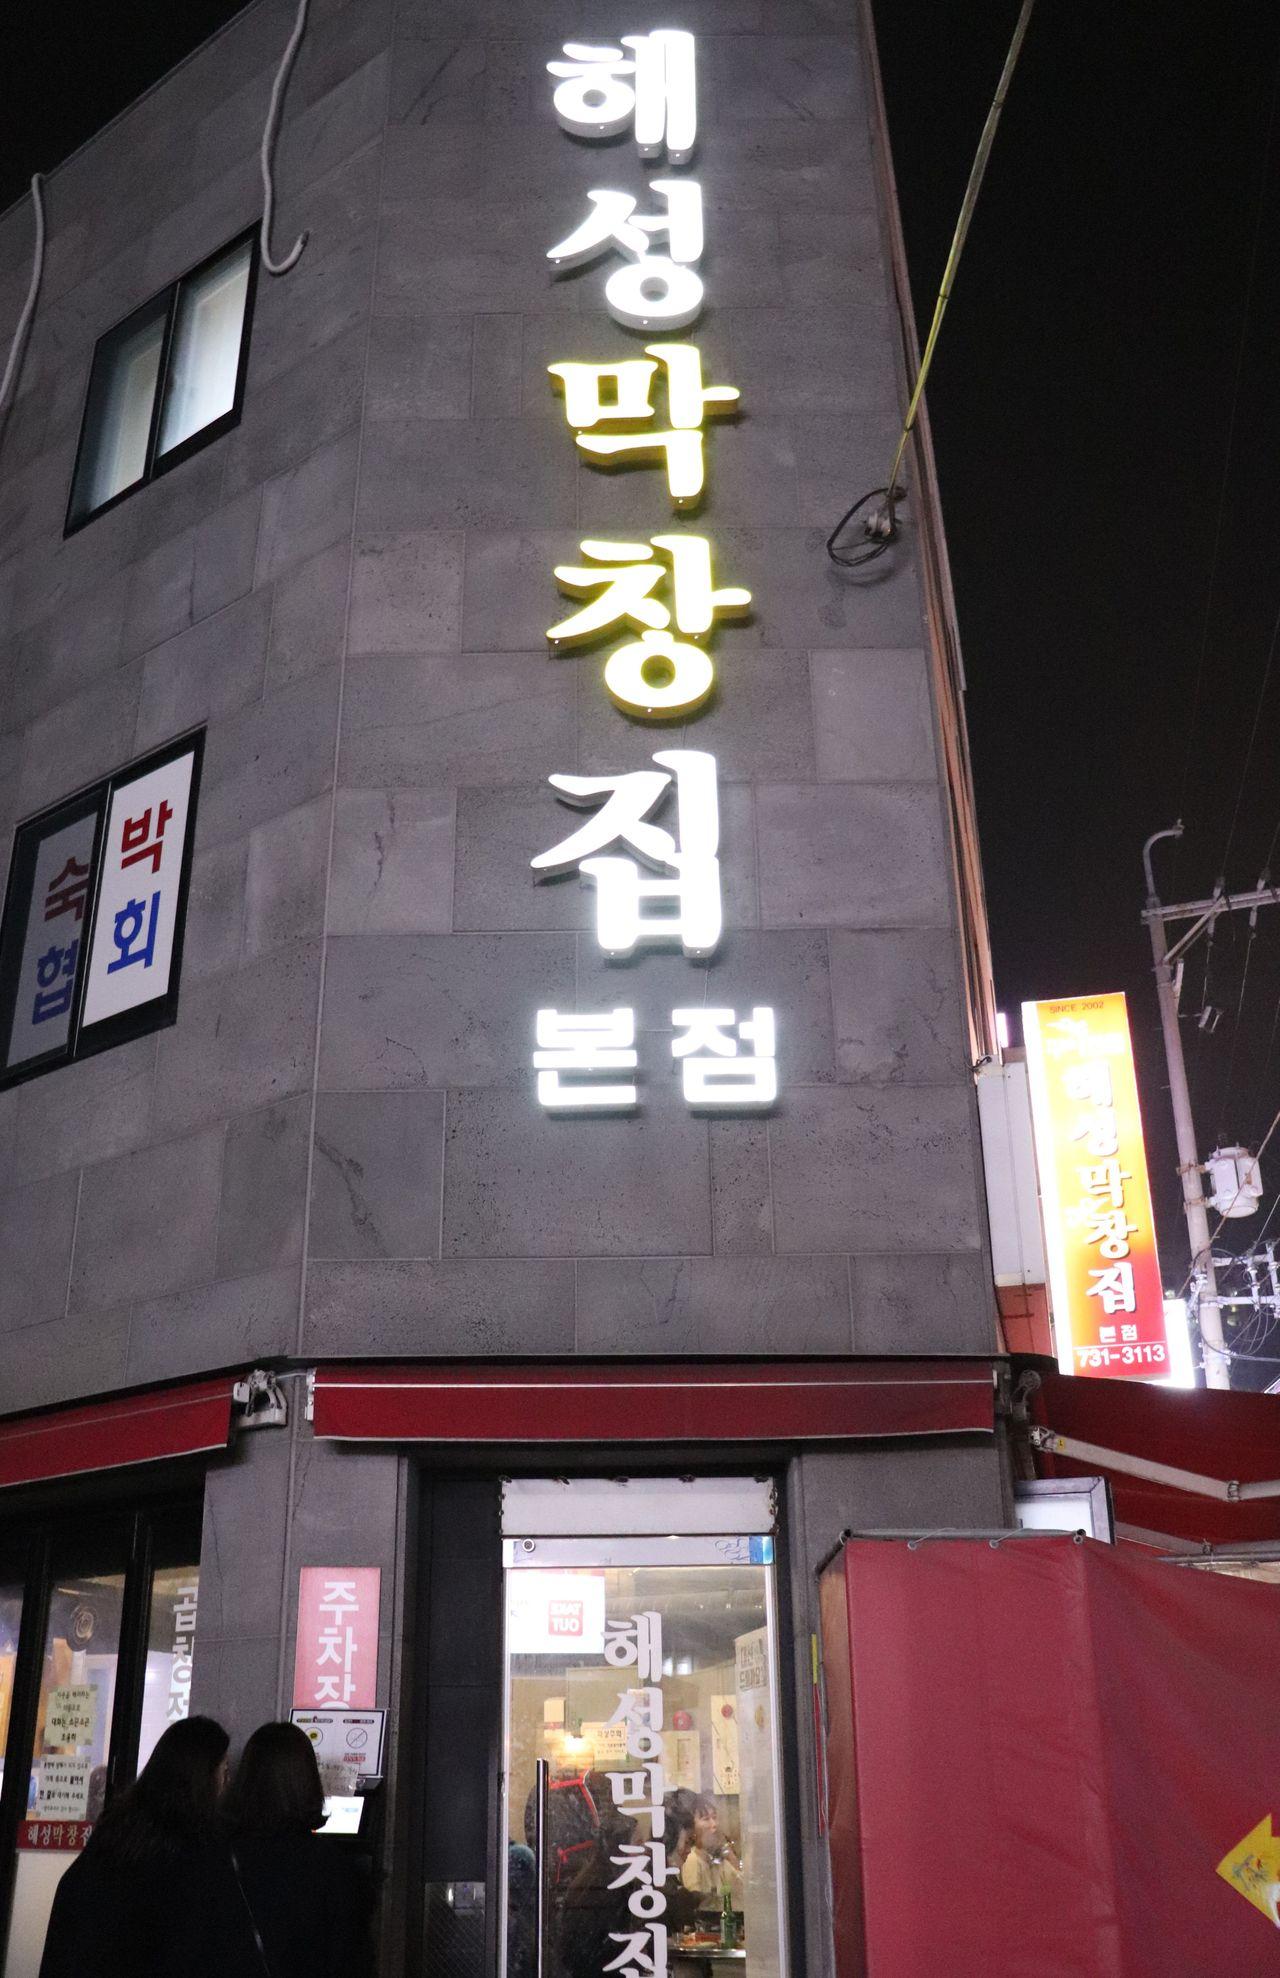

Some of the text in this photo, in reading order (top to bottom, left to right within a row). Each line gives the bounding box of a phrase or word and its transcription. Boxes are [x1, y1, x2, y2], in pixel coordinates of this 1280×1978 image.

[531, 29, 752, 956] 해성막창집
[533, 1006, 778, 1108] 본점
[1049, 1001, 1104, 1014] SINCE 2002
[1077, 1344, 1166, 1368] 731-3113
[314, 1581, 360, 1708] 주차장
